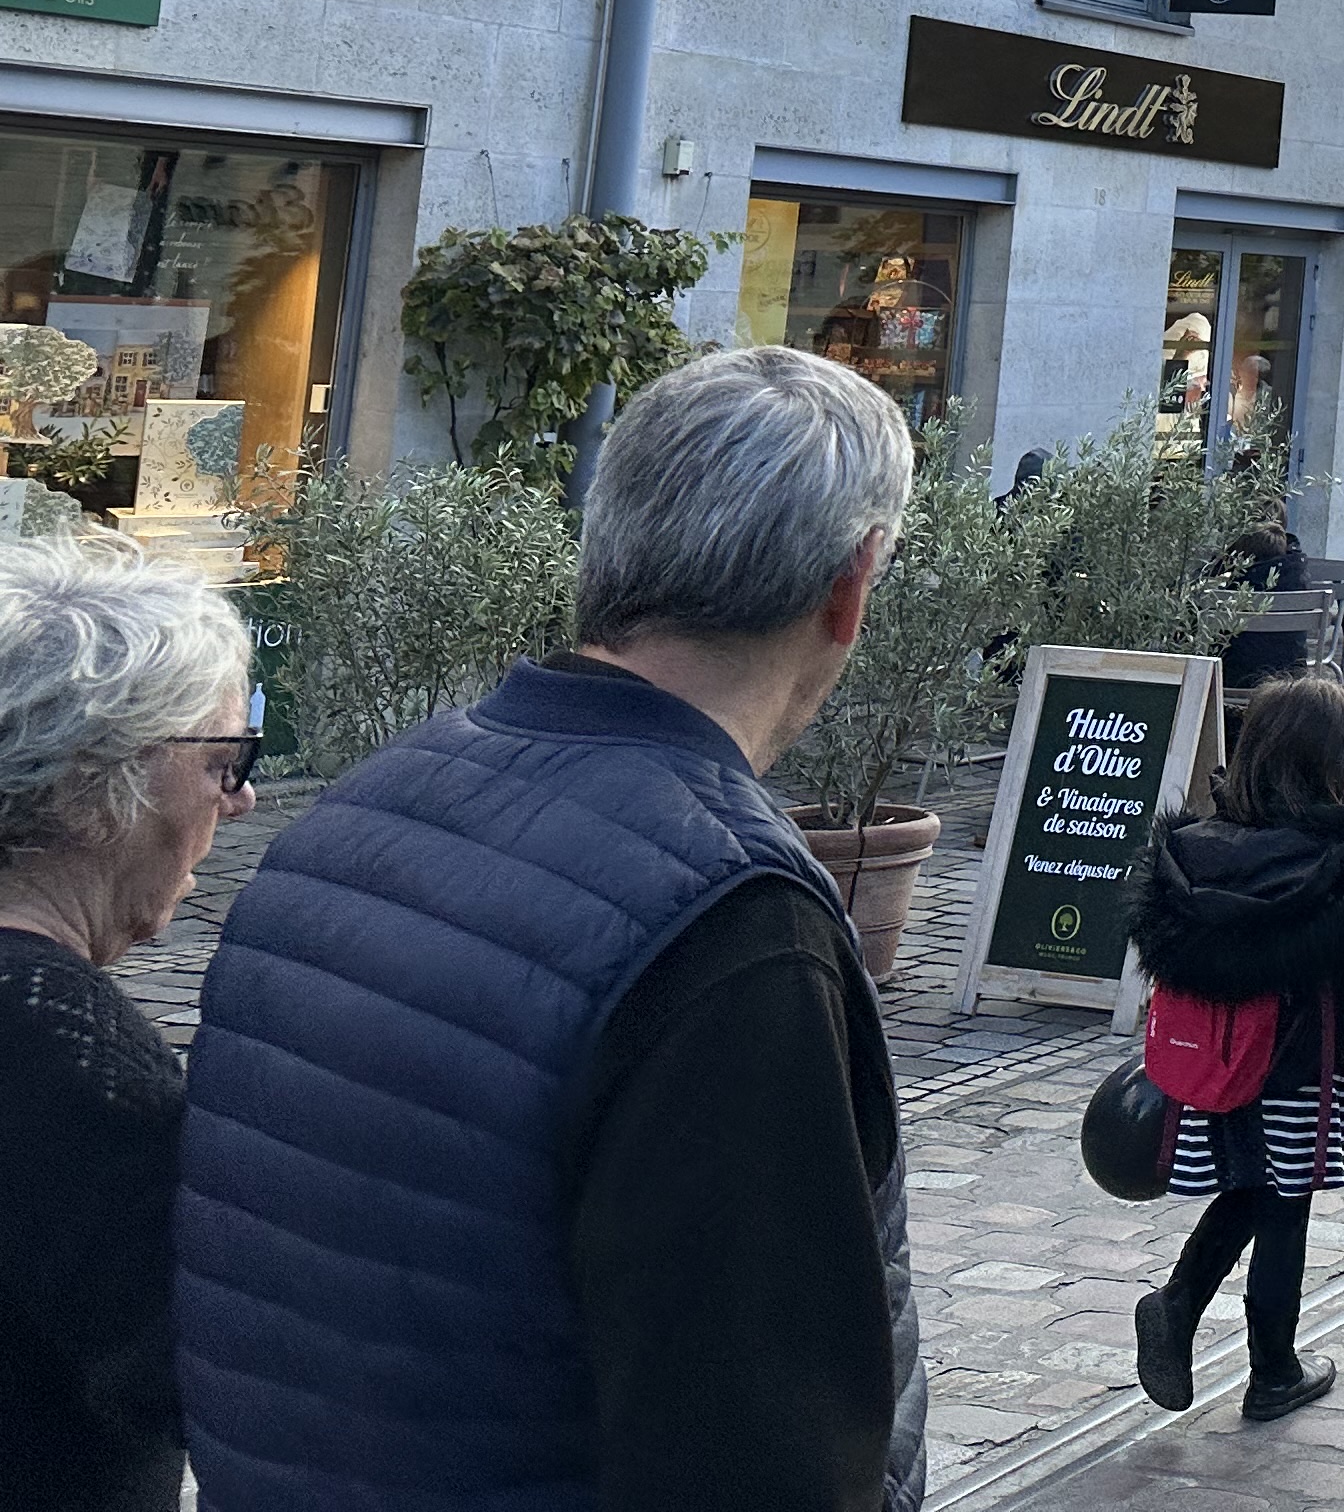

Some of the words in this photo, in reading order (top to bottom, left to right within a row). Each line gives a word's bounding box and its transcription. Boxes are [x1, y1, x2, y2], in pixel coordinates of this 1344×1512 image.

[1036, 63, 1171, 139] Lindt
[1170, 270, 1215, 288] Lindt
[1065, 707, 1148, 743] Huiles
[1053, 744, 1142, 779] d'Olive
[1036, 786, 1053, 807] &
[1057, 788, 1144, 819] Vinaigres
[1043, 813, 1066, 834] de
[1066, 817, 1128, 839] saison
[1024, 854, 1062, 873] Venez
[1063, 859, 1123, 882] déguster
